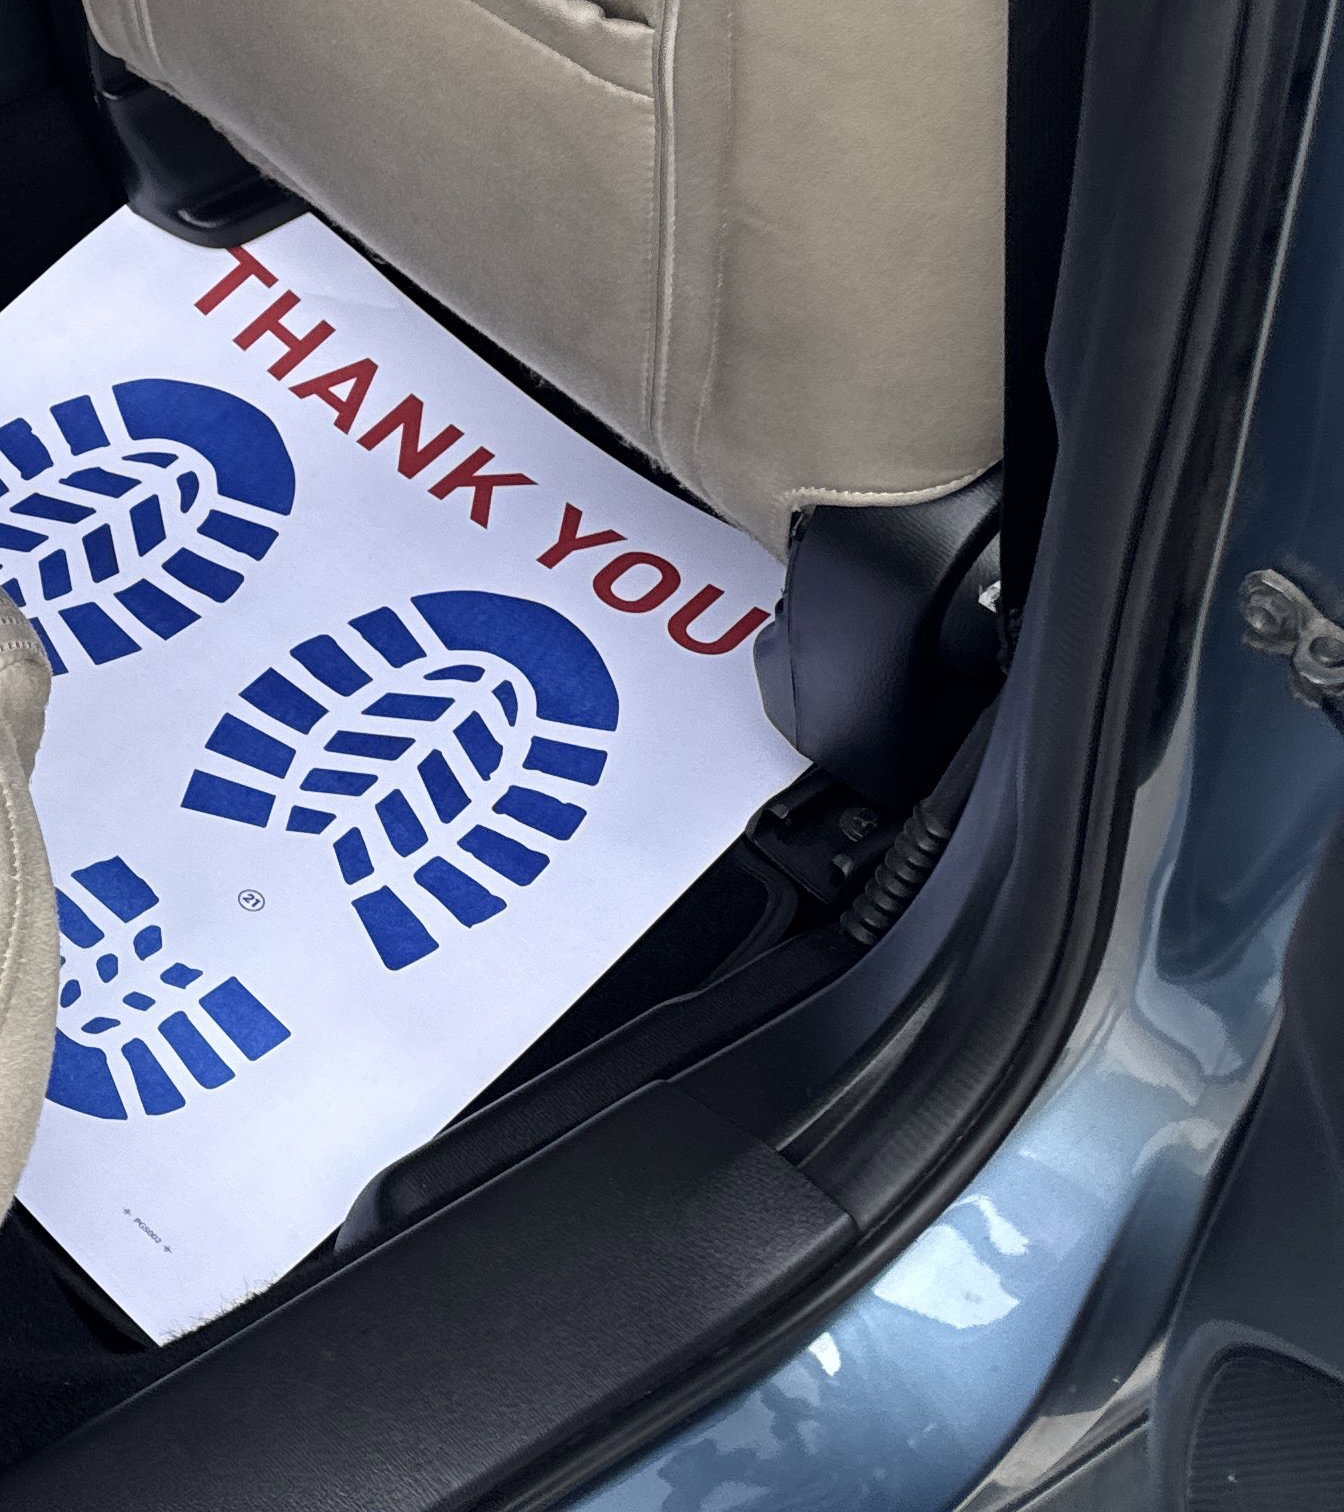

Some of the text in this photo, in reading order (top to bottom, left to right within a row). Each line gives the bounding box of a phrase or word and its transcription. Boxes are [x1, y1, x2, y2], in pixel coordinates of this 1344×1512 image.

[193, 244, 771, 656] THANK YOU
[241, 892, 262, 909] 21
